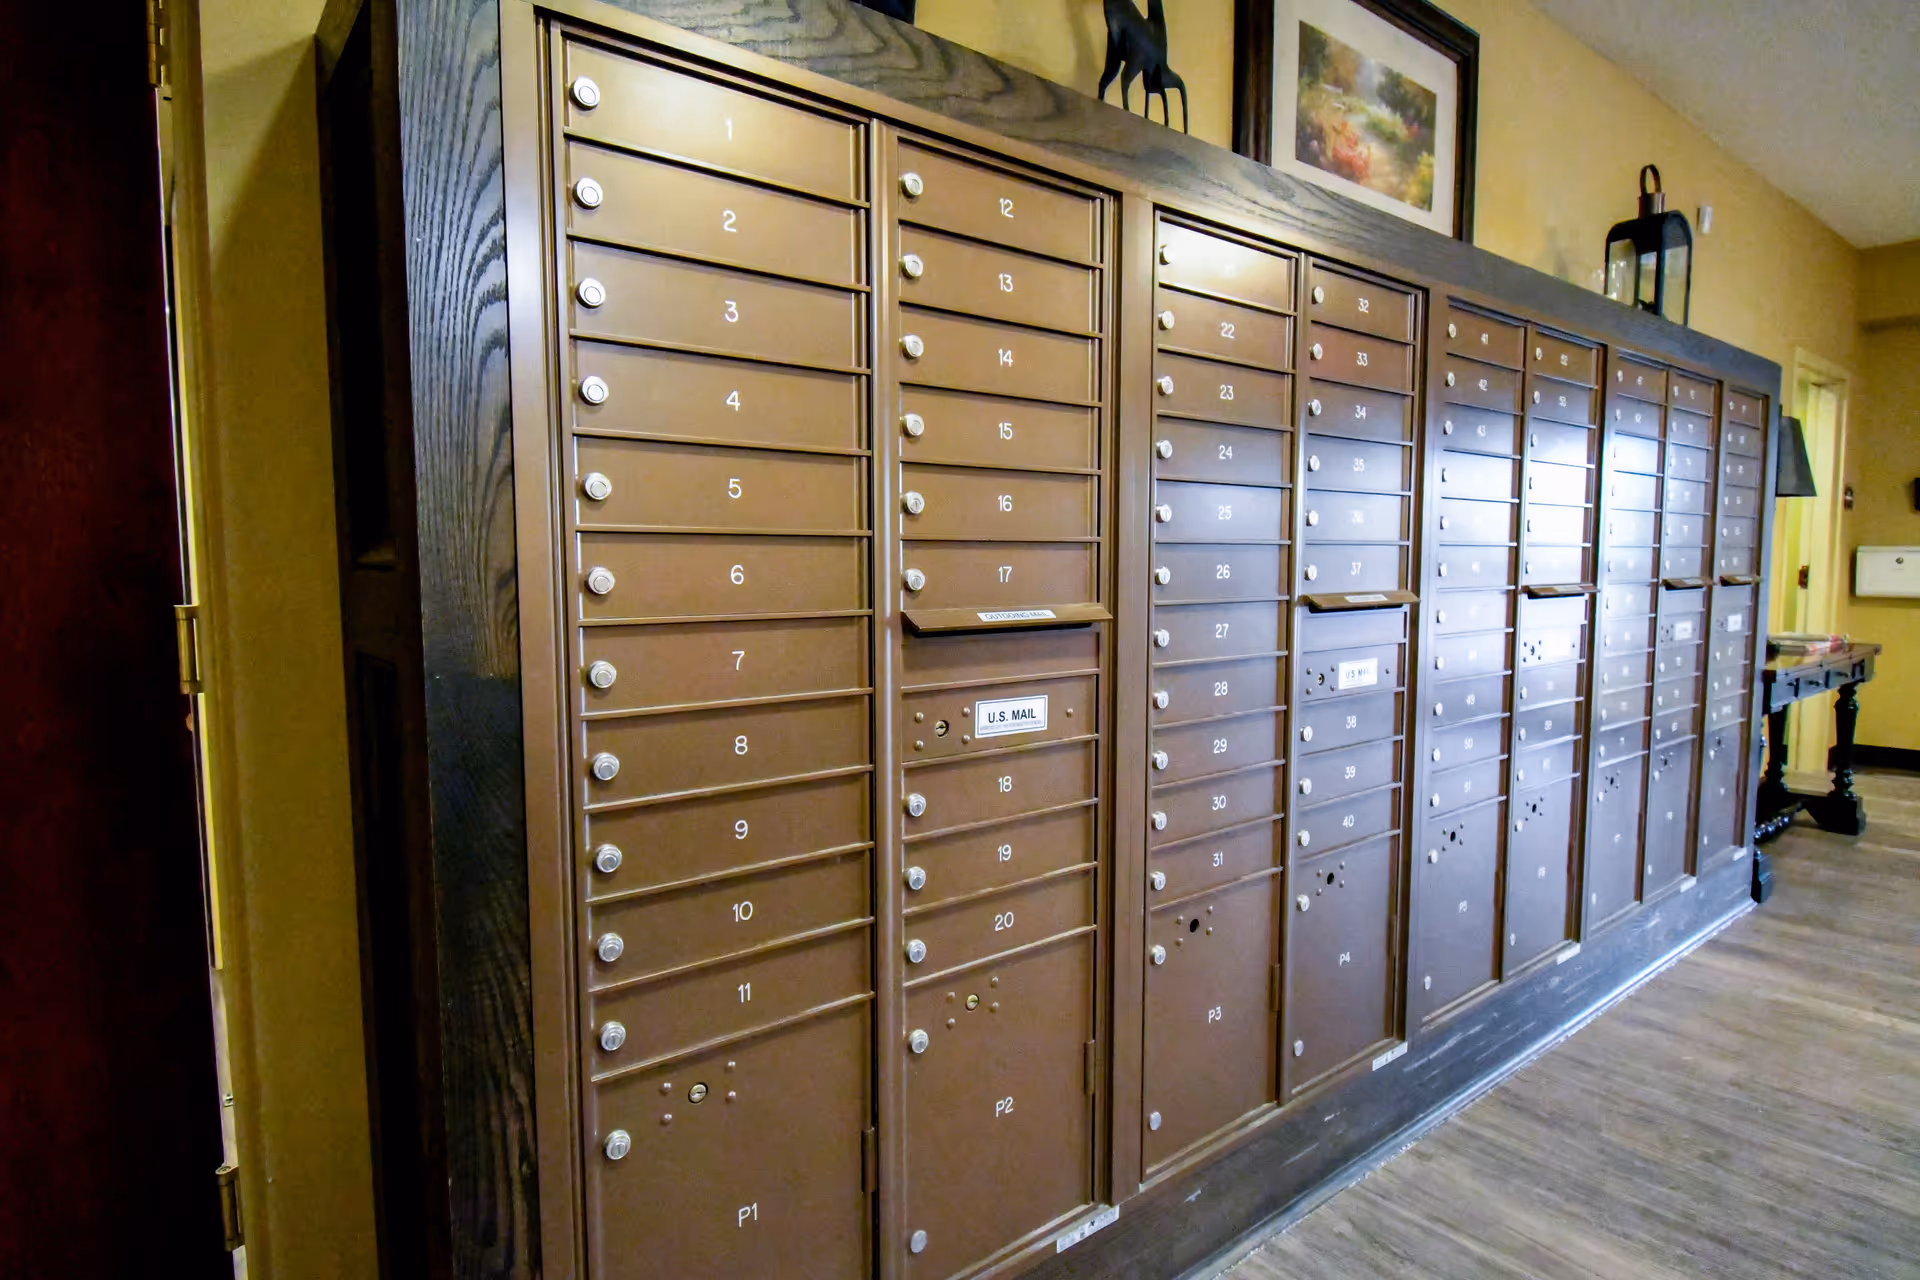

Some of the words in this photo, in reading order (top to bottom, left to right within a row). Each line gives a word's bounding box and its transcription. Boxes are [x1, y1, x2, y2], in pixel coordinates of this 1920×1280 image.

[725, 117, 733, 142] 1
[999, 197, 1014, 219] 12
[722, 209, 737, 233] 2
[998, 273, 1014, 293] 13
[724, 300, 739, 323] 3
[1358, 297, 1370, 314] 32
[1220, 321, 1235, 340] 22
[998, 348, 1014, 367] 14
[1356, 351, 1368, 367] 33
[1219, 384, 1234, 401] 23
[1478, 378, 1488, 392] 42
[726, 390, 741, 412] 4
[1354, 404, 1367, 420] 34
[998, 422, 1013, 441] 15
[1218, 444, 1233, 460] 24
[1352, 457, 1365, 472] 35
[727, 478, 742, 499] 5
[997, 494, 1013, 512] 16
[1218, 505, 1233, 521] 25
[730, 564, 745, 585] 6
[998, 565, 1013, 583] 17
[1216, 564, 1231, 580] 26
[1350, 561, 1362, 576] 37
[984, 611, 1030, 621] OUTGOING
[1030, 610, 1049, 619] MAIL
[1215, 623, 1229, 639] 27
[731, 650, 745, 671] 7
[1214, 681, 1228, 697] 28
[988, 711, 1009, 723] U.S.
[1011, 708, 1036, 721] MAIL
[1345, 715, 1357, 729] 38
[734, 735, 749, 755] 8
[1213, 738, 1228, 754] 29
[1344, 765, 1356, 780] 39
[998, 775, 1013, 793] 18
[1212, 794, 1227, 811] 30
[734, 819, 749, 840] 9
[1342, 814, 1355, 828] 40
[997, 844, 1012, 862] 19
[1212, 851, 1223, 868] 31
[732, 900, 754, 923] 10
[994, 911, 1015, 931] 20
[1339, 951, 1351, 967] P4
[737, 982, 751, 1003] 11
[1208, 1006, 1222, 1024] P3
[995, 1096, 1014, 1118] P2
[738, 1202, 758, 1228] P1
